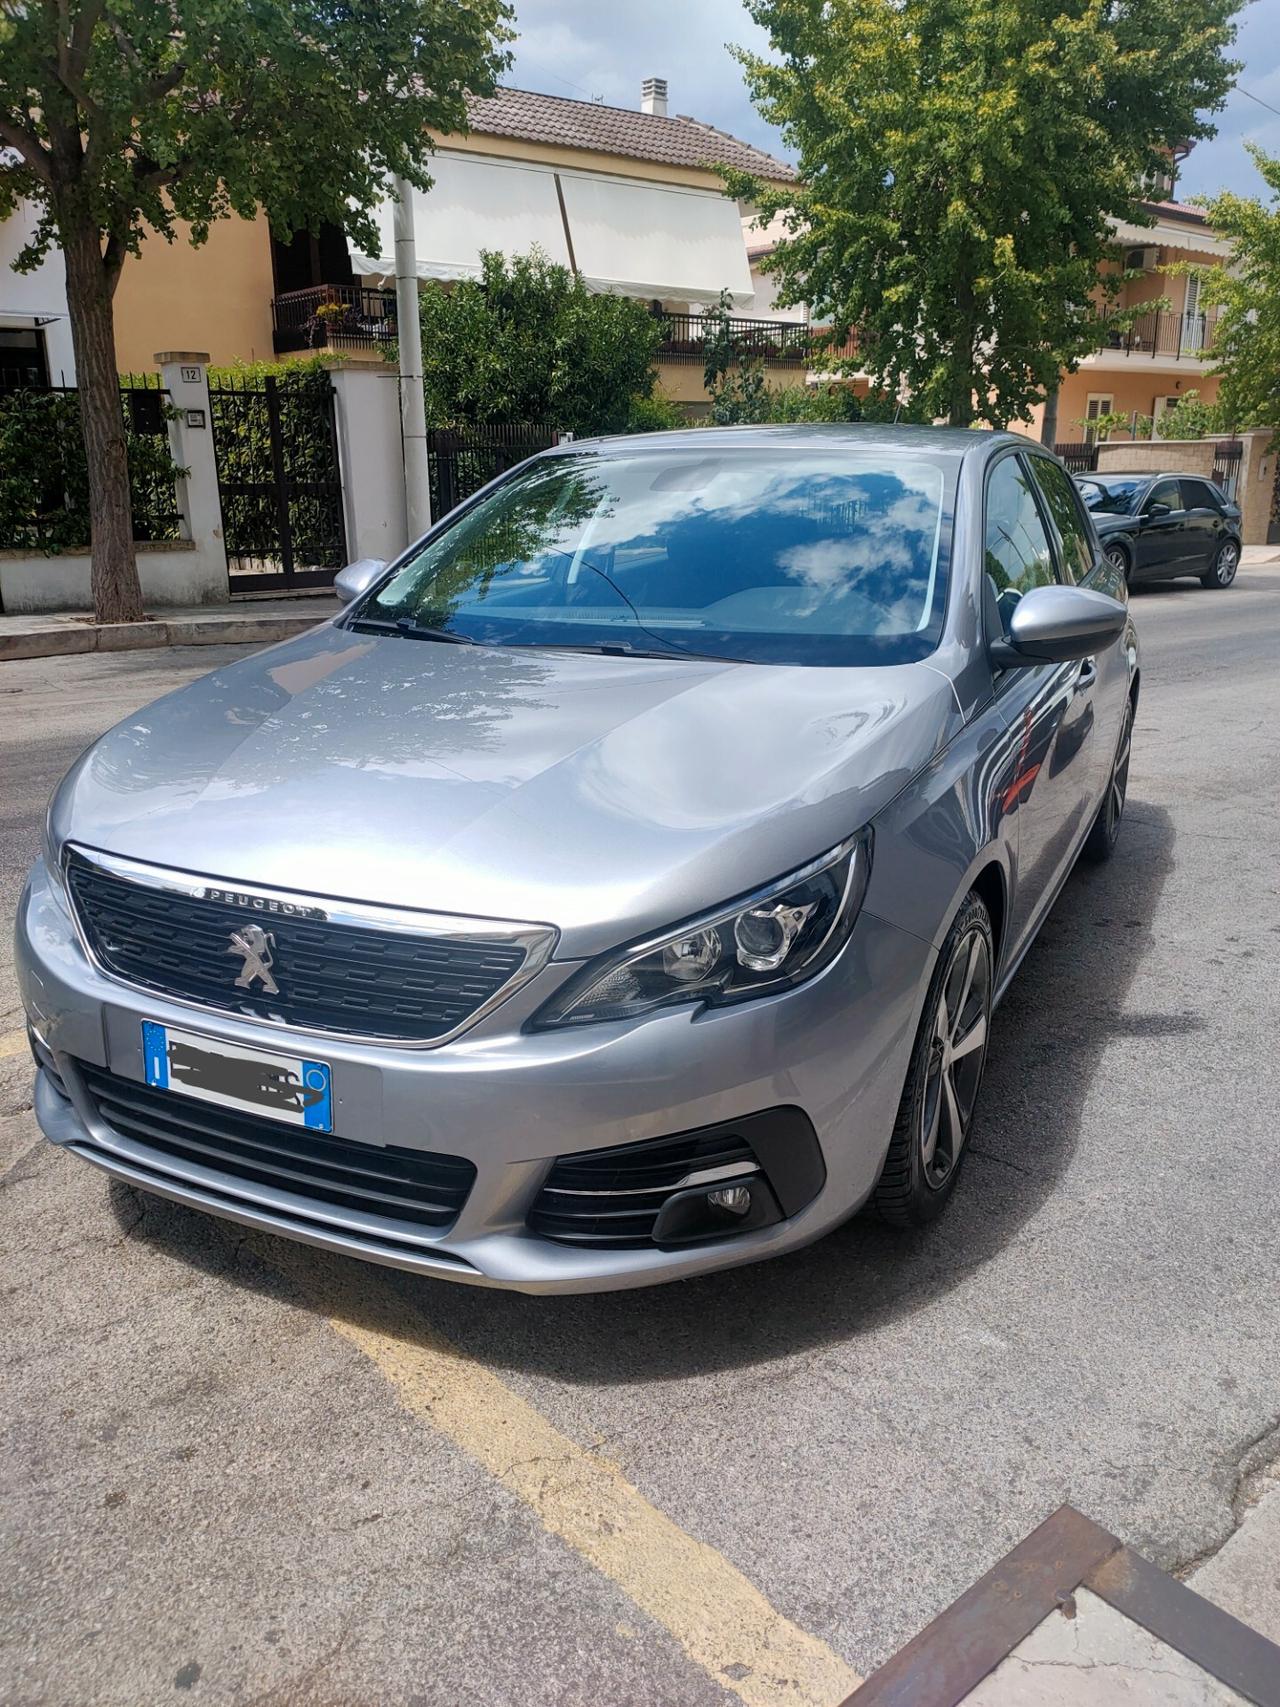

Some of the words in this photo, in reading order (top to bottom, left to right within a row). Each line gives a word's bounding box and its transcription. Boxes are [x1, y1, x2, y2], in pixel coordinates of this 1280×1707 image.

[186, 370, 197, 380] 12
[210, 889, 312, 917] PEUGEOT
[153, 1056, 161, 1080] I
